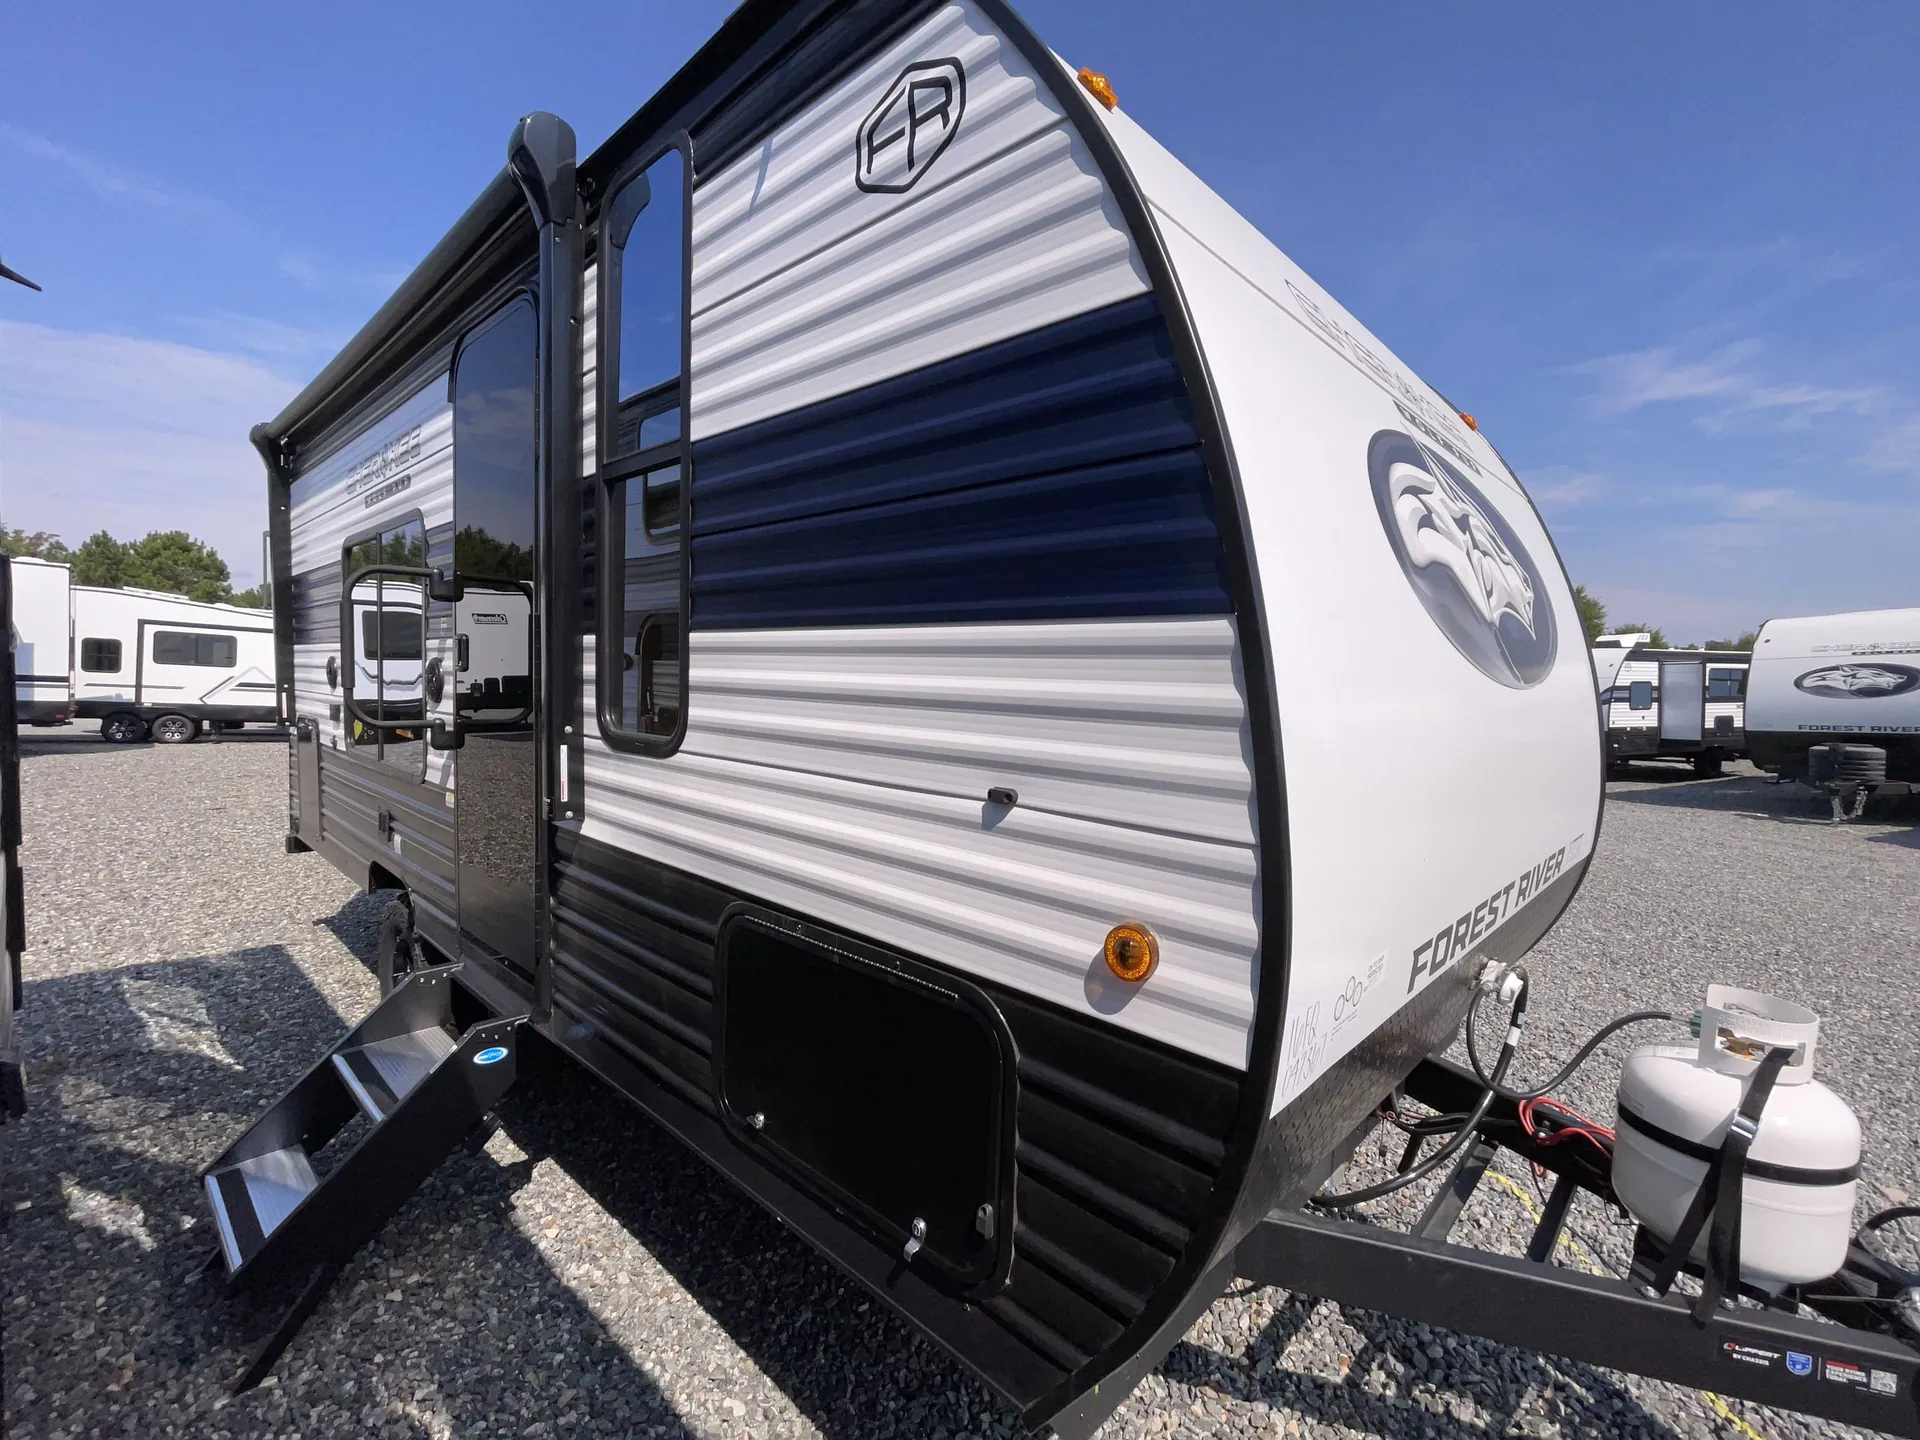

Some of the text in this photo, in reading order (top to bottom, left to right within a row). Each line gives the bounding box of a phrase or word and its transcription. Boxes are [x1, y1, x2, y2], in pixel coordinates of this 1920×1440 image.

[1399, 405, 1444, 447] WOLF
[1797, 724, 1866, 733] FOREST
[1407, 846, 1566, 995] FOREST RIVER
[1735, 1345, 1781, 1358] LIPPERT
